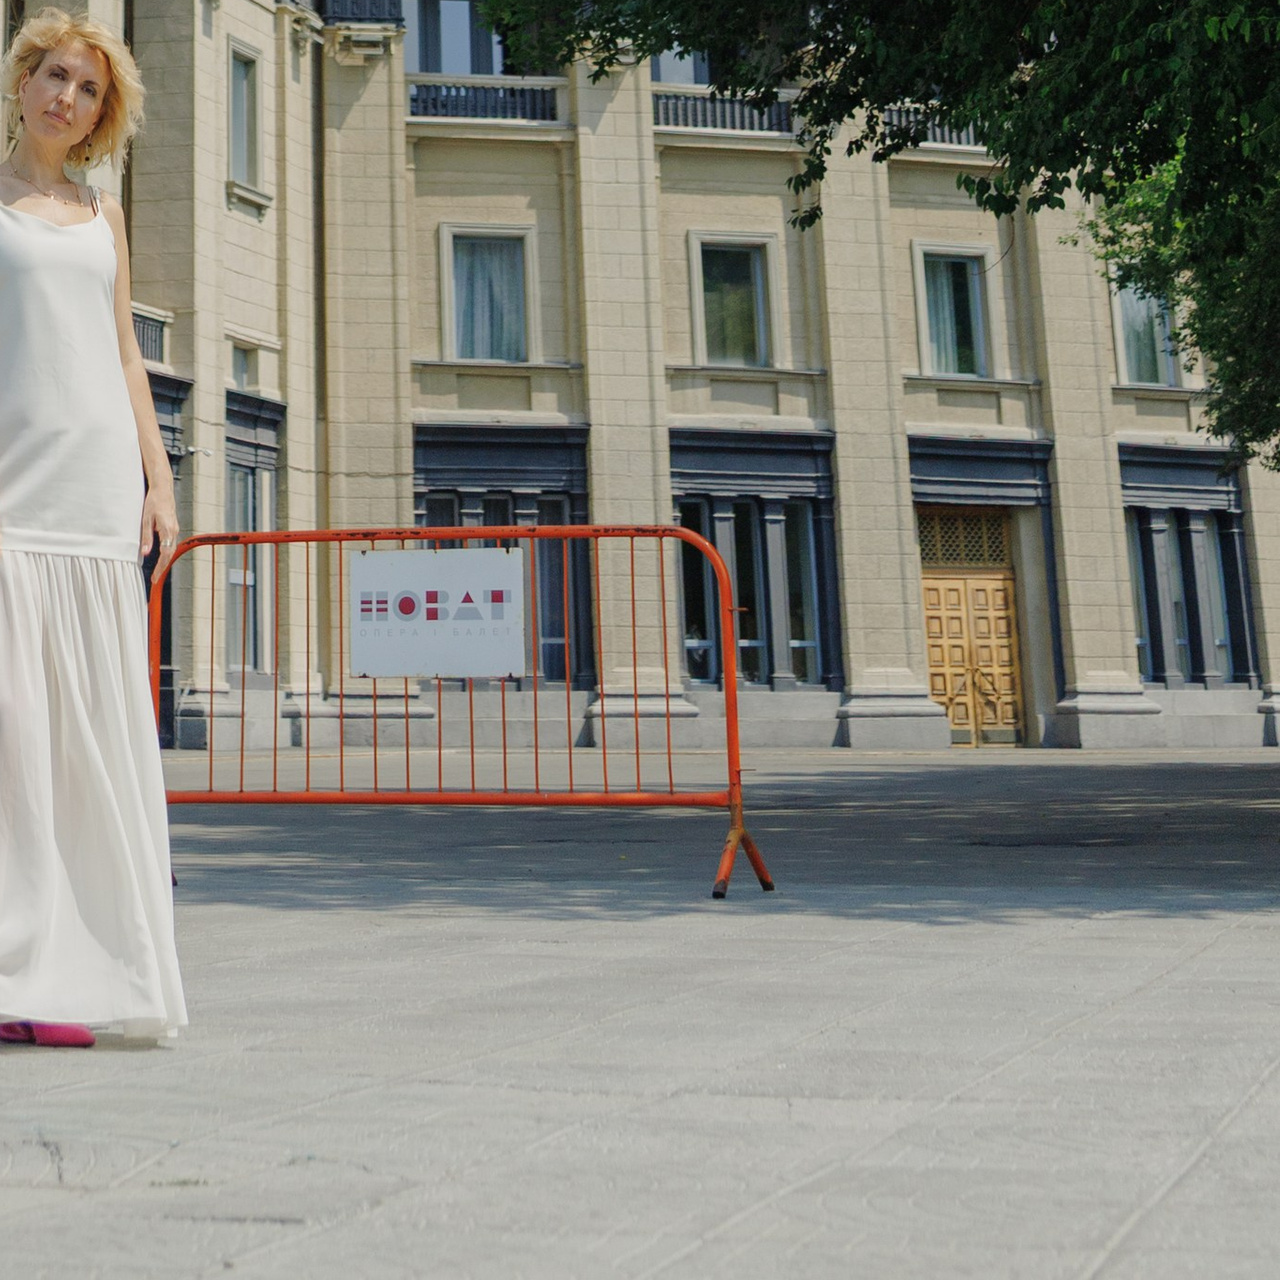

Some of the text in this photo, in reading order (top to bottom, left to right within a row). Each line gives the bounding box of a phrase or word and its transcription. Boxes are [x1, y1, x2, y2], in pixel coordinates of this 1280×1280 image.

[360, 589, 512, 622] НОВАТ
[360, 628, 419, 637] ОПЕРА
[453, 627, 511, 636] БАЛЕТ
